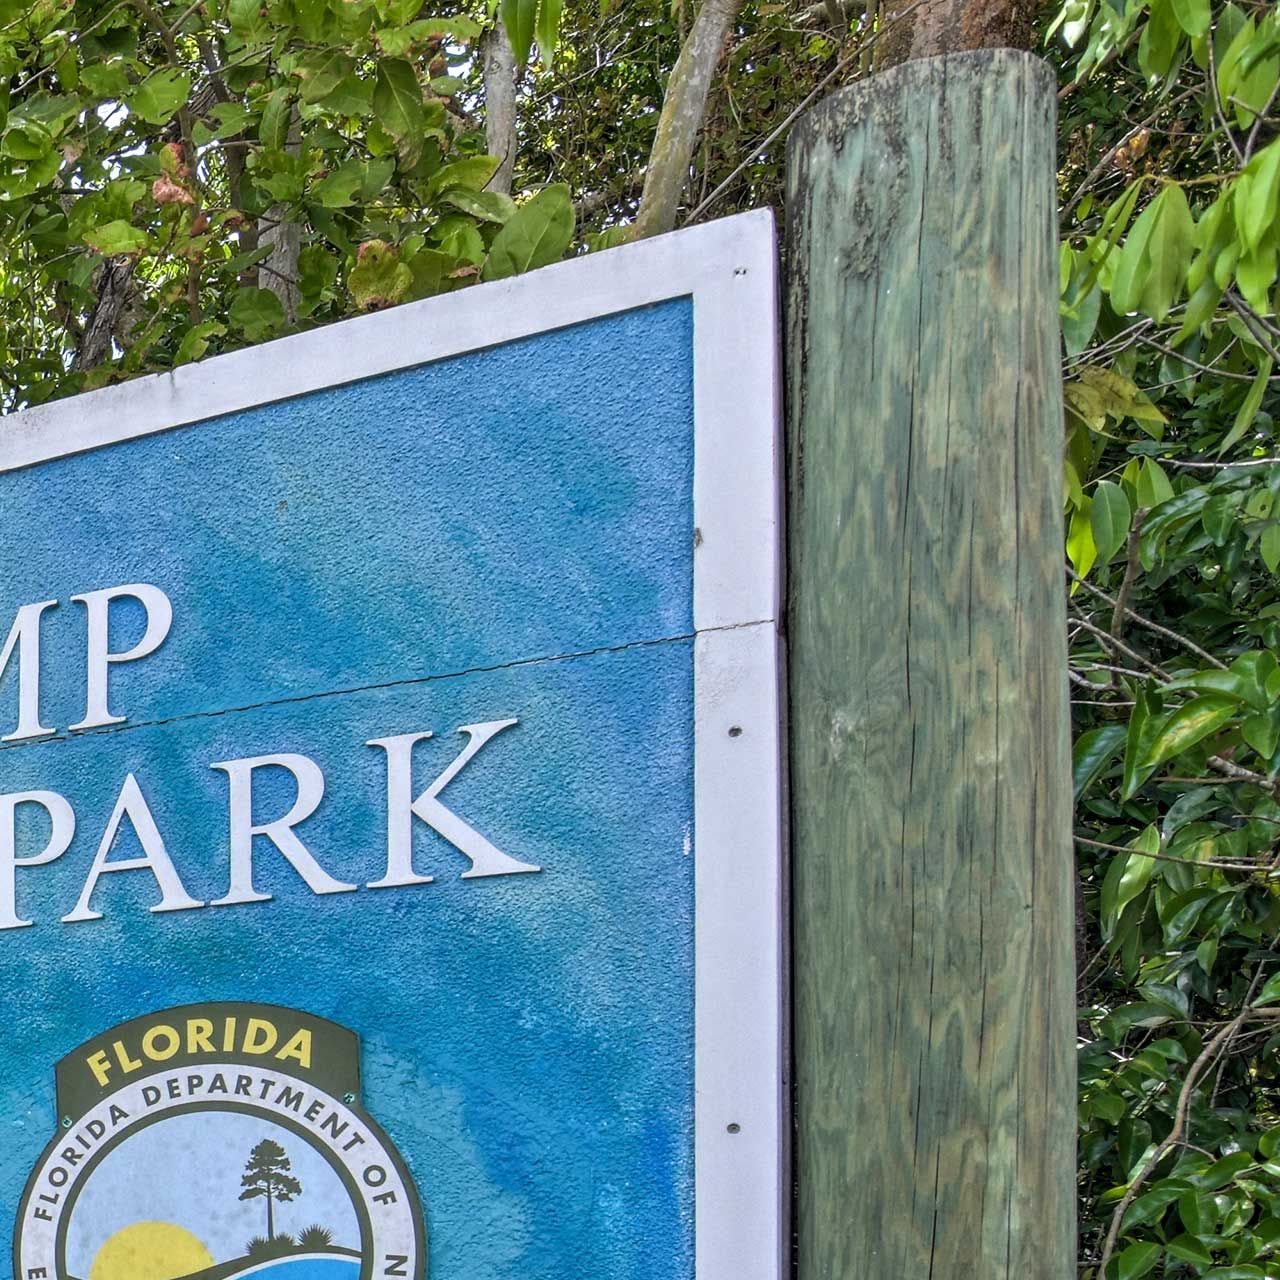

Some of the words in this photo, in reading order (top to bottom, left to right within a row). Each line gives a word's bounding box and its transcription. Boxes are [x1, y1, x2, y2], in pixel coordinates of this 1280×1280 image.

[86, 1017, 313, 1086] FLORIDA
[34, 1103, 131, 1223] FLORIDA
[142, 1074, 366, 1152] DEPARTMENT
[362, 1163, 398, 1208] OF
